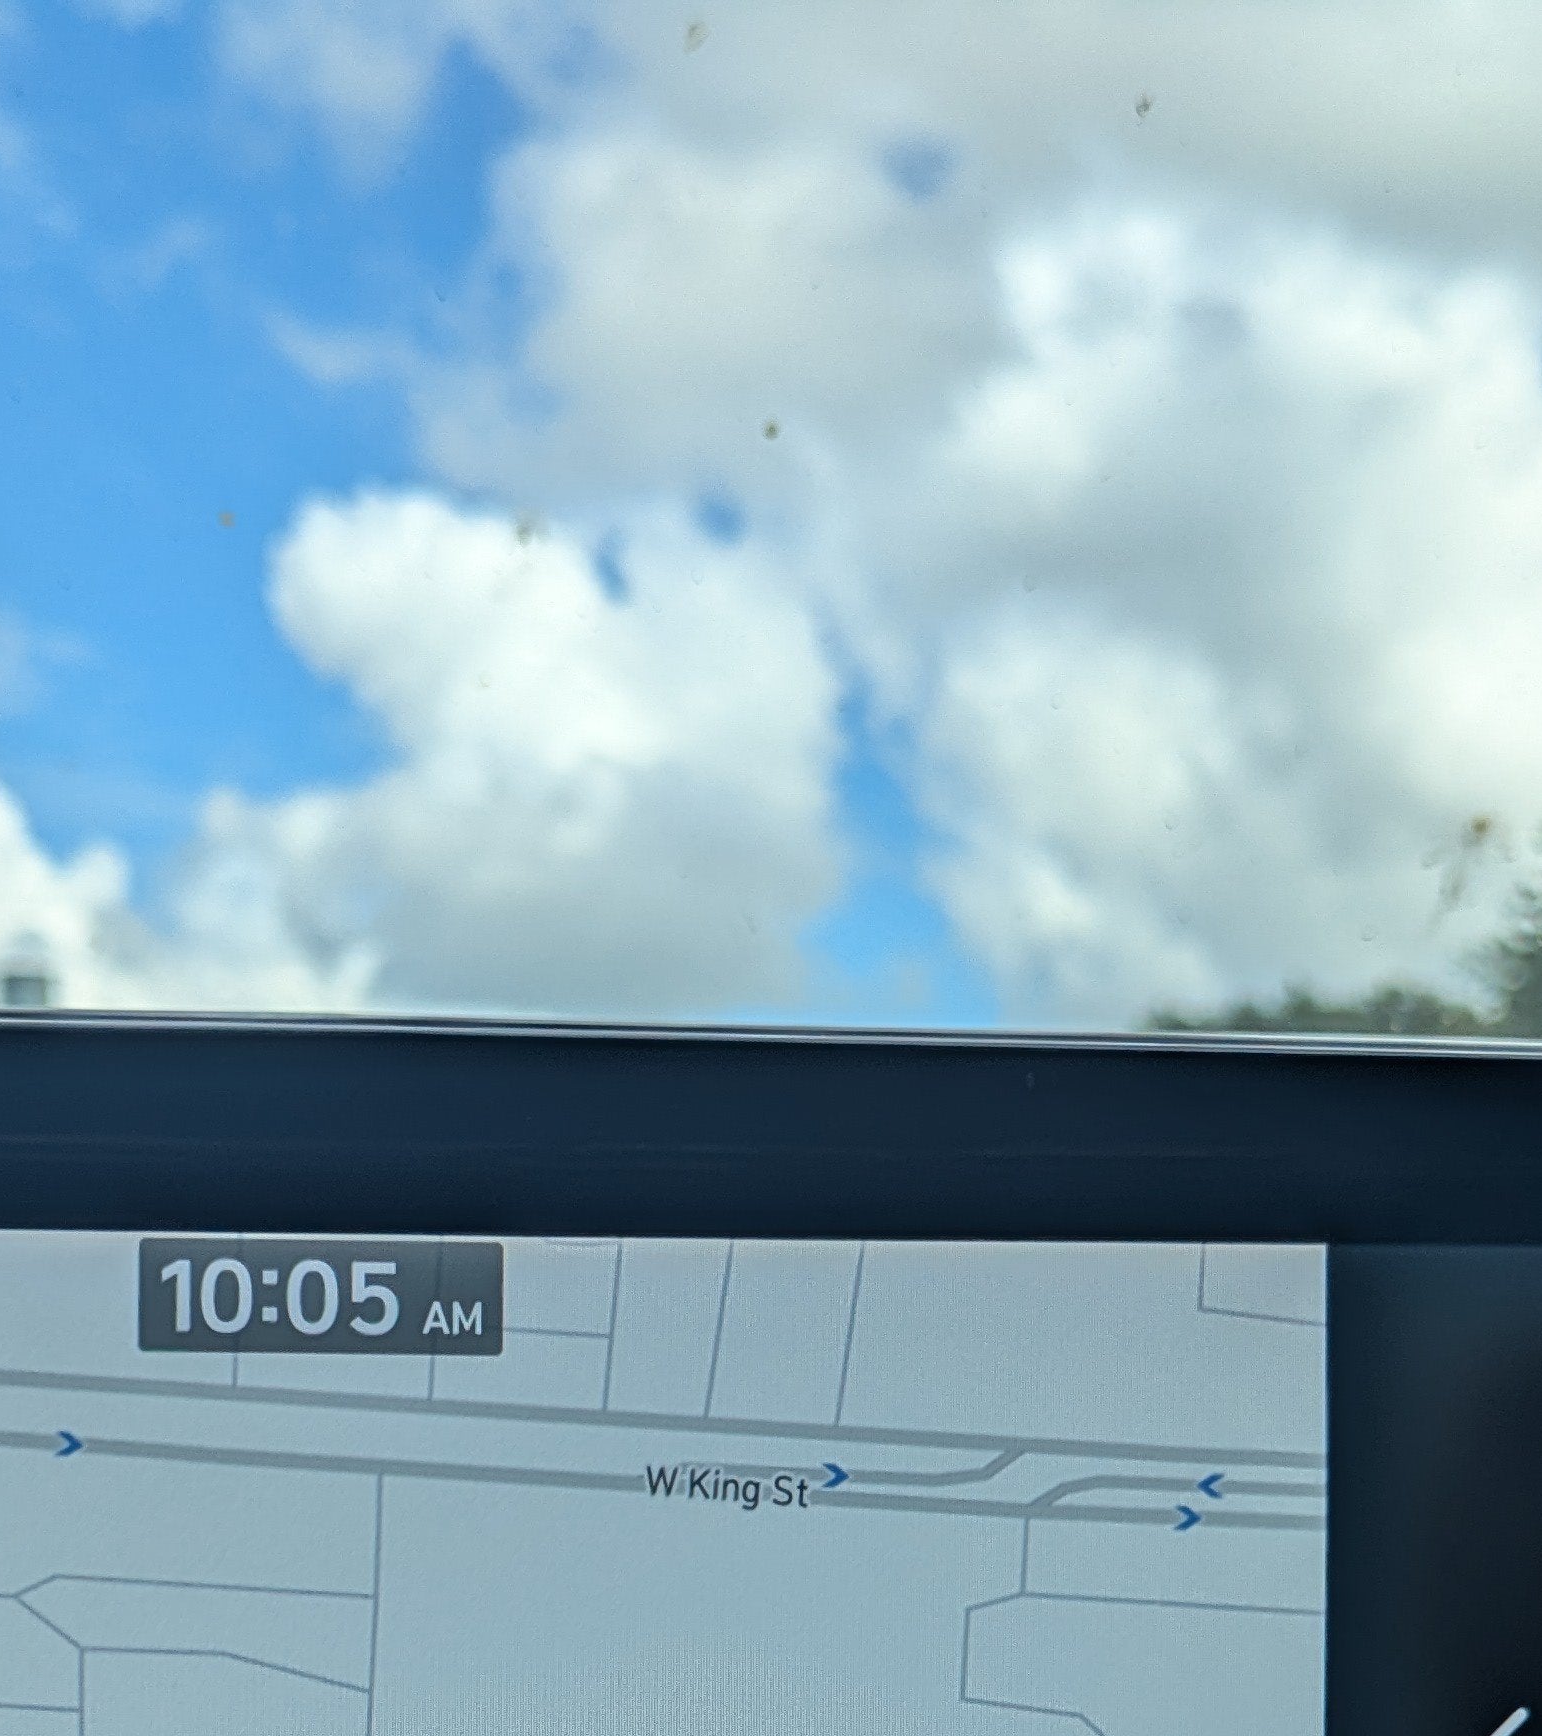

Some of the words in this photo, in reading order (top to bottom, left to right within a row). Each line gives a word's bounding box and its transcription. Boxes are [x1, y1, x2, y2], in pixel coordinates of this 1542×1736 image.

[159, 1257, 401, 1337] 10:05
[422, 1300, 484, 1337] AM
[645, 1465, 681, 1498] W
[687, 1468, 762, 1511] King
[771, 1473, 810, 1509] St
